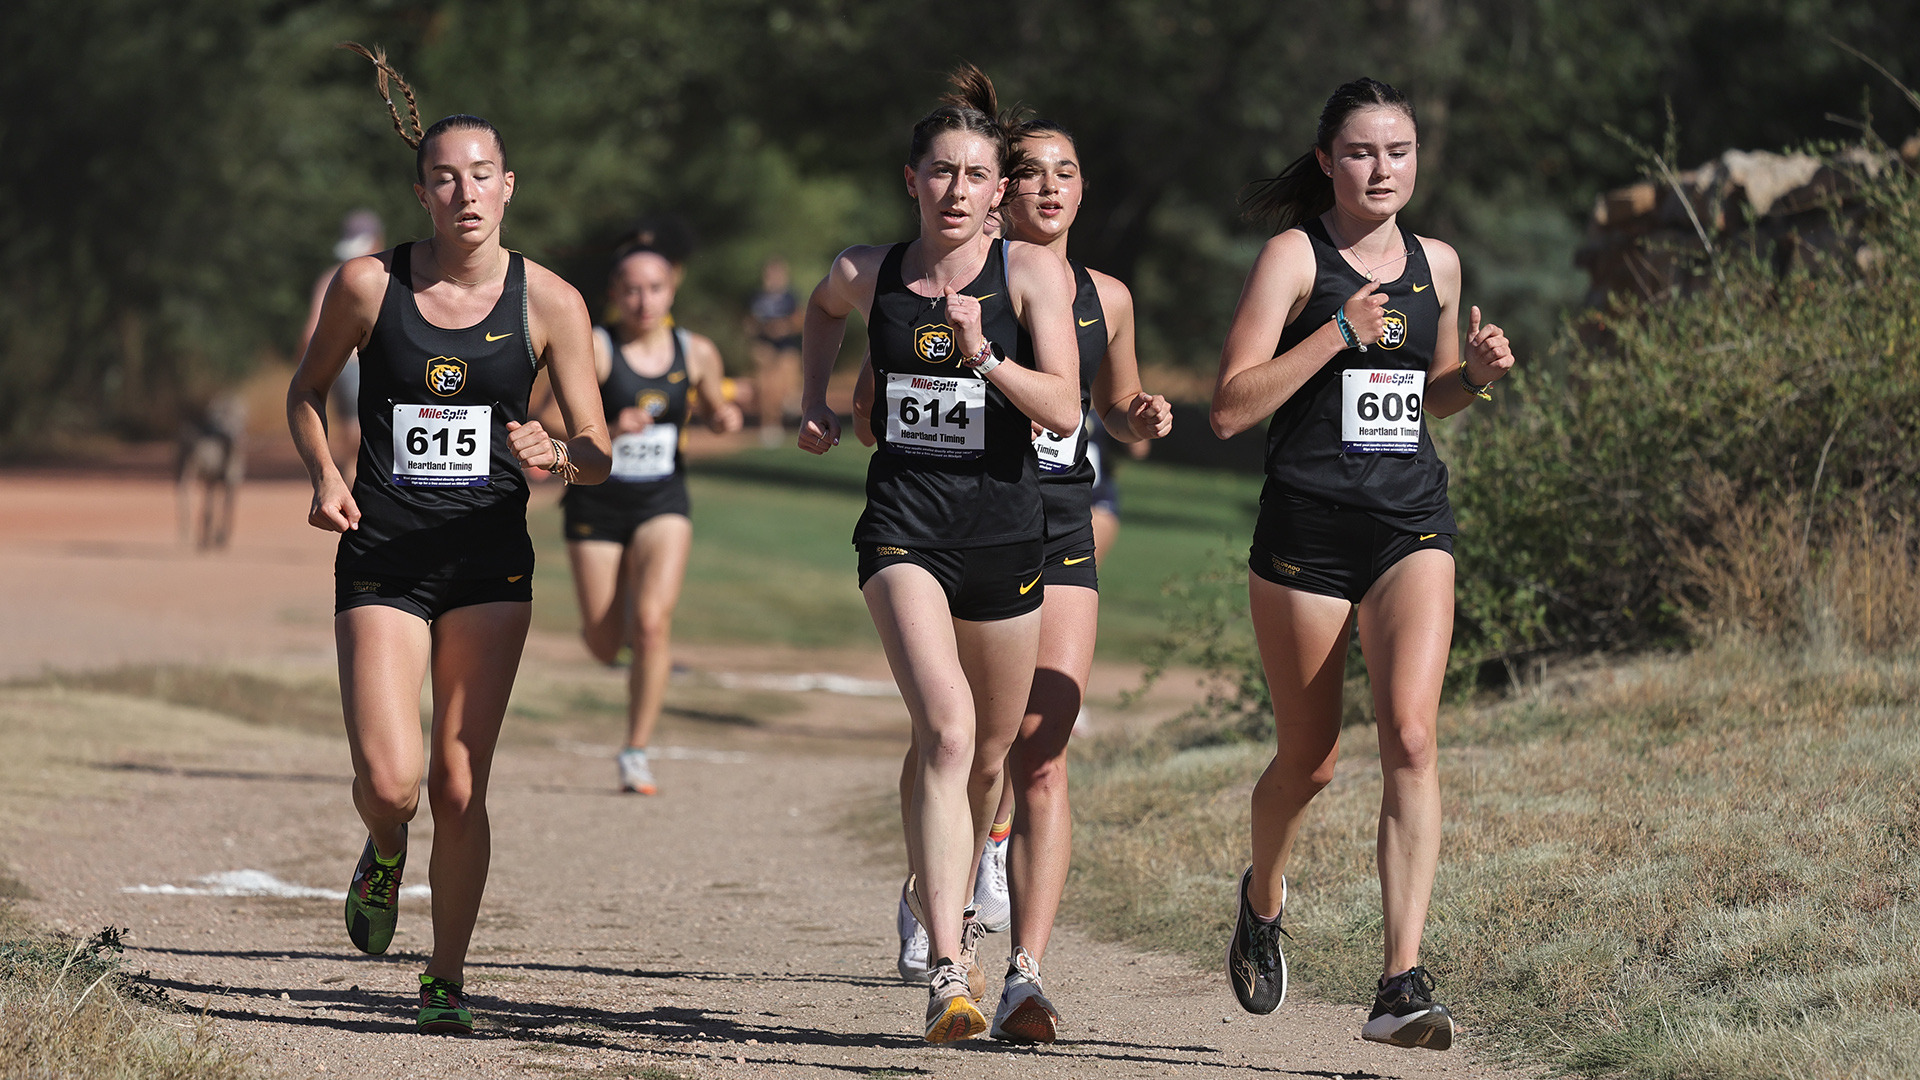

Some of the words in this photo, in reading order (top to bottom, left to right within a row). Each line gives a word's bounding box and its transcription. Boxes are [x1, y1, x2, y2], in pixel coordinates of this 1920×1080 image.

[911, 378, 958, 392] MileSplit
[1369, 373, 1414, 386] MileSplit
[900, 397, 969, 429] 614
[1357, 392, 1420, 422] 609
[418, 408, 468, 421] MileSplit
[901, 430, 937, 442] Heartland
[940, 433, 965, 444] Timing
[1359, 427, 1397, 436] Heartland
[406, 427, 476, 456] 615
[1037, 444, 1059, 458] Timing
[408, 461, 446, 470] Heartland
[449, 462, 472, 471] Timing
